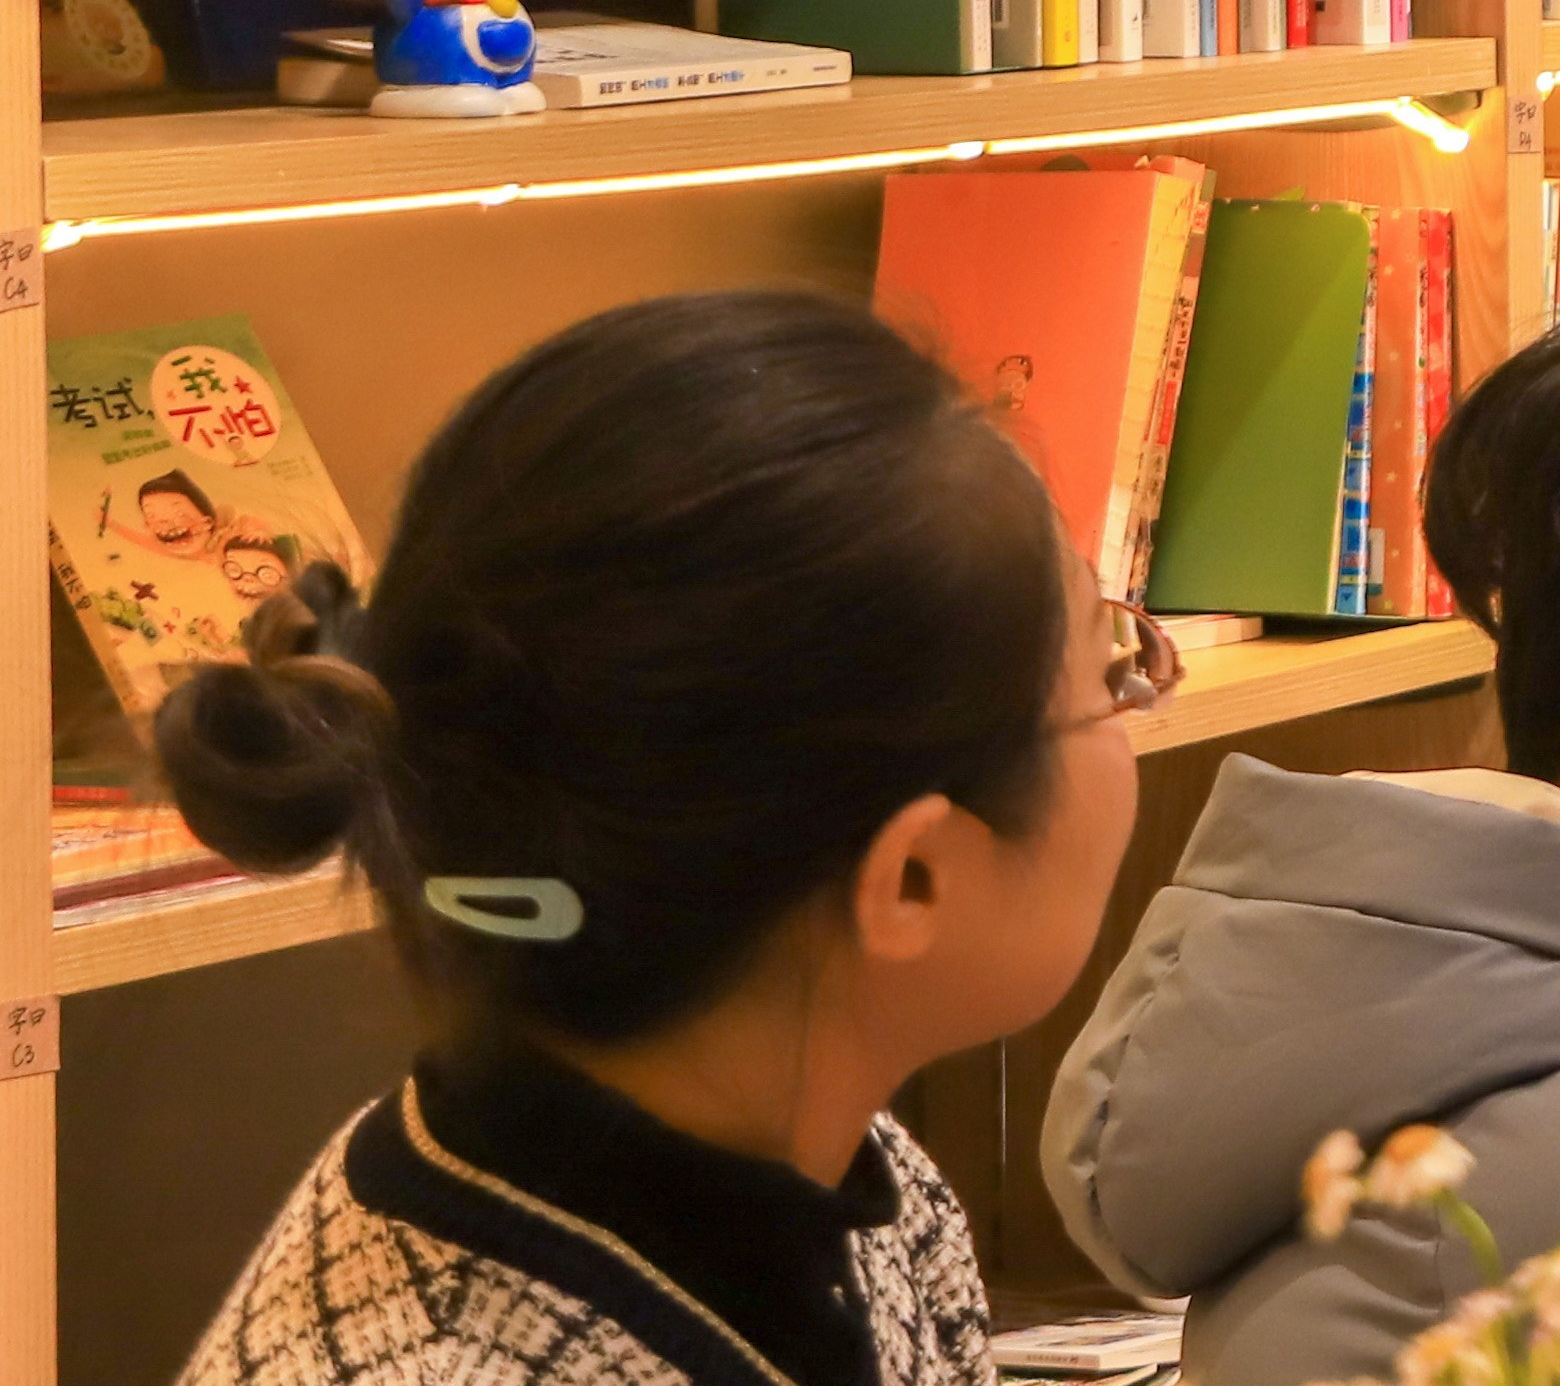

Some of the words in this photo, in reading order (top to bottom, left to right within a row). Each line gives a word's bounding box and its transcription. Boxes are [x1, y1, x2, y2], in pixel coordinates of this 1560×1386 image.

[171, 354, 228, 399] 我
[168, 397, 279, 449] 不怕
[12, 1042, 35, 1068] C3
